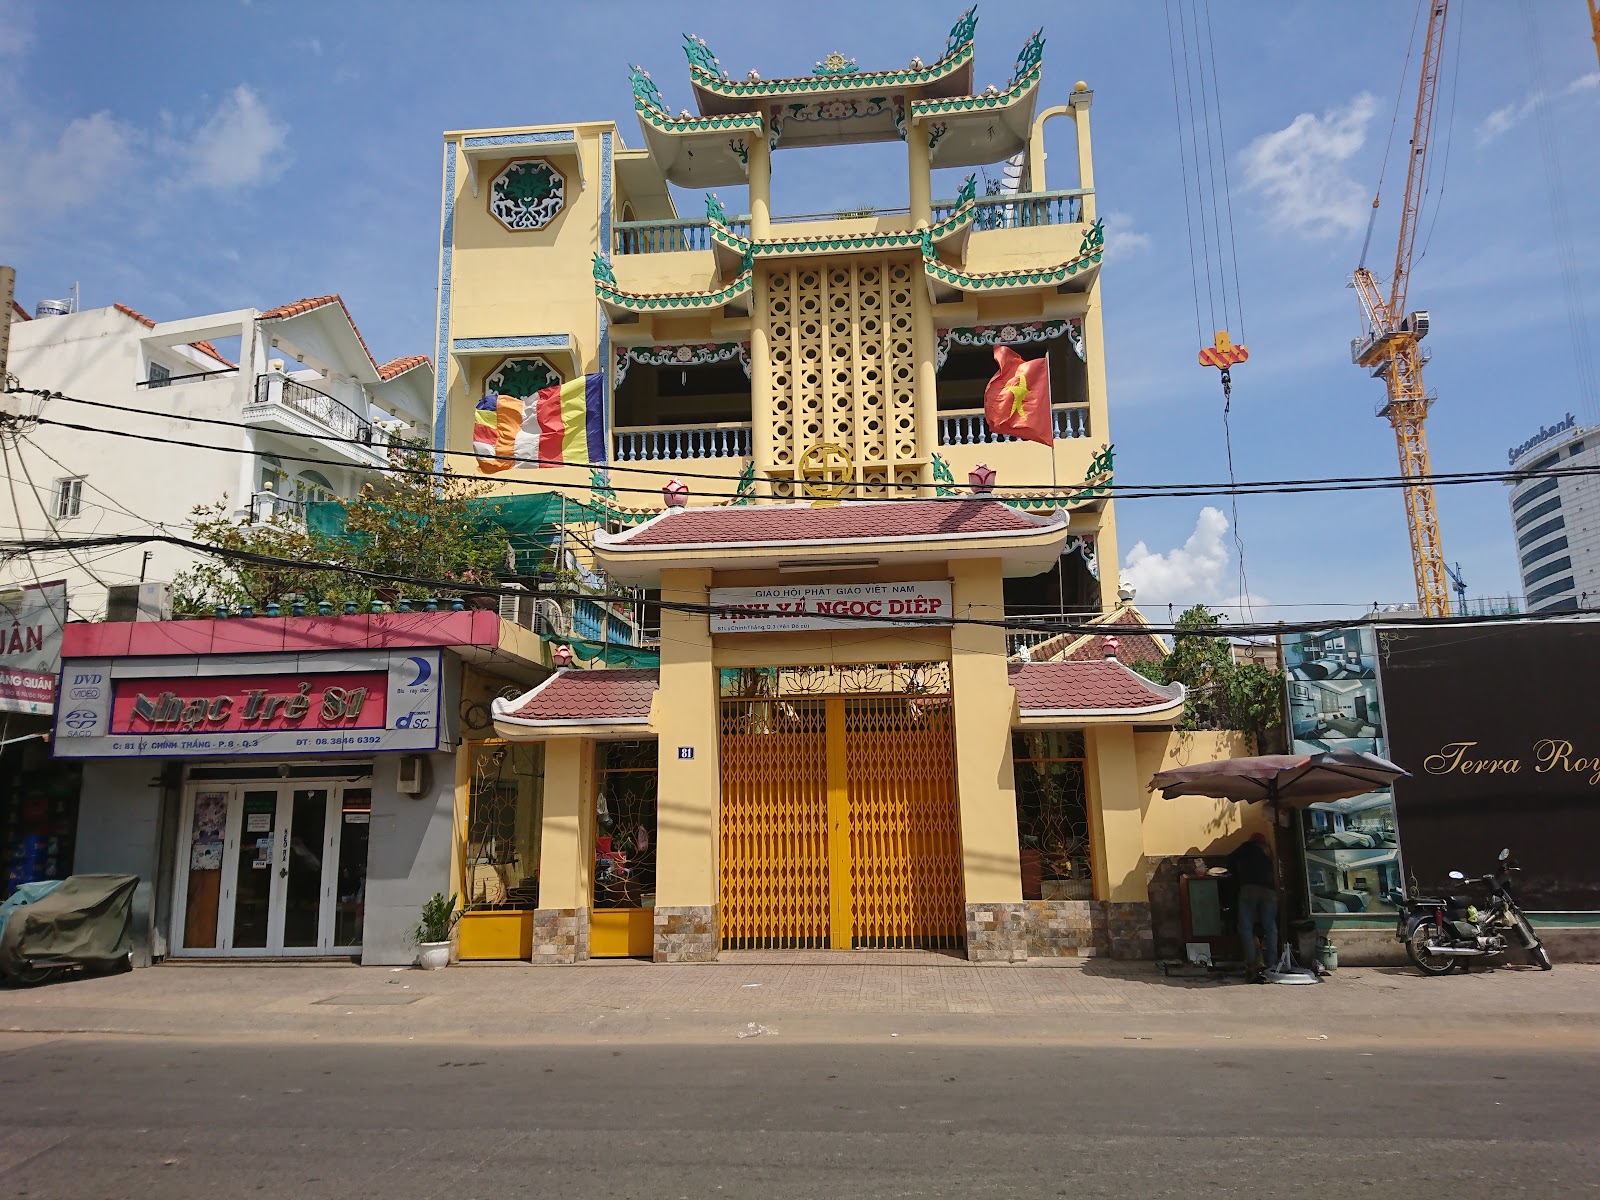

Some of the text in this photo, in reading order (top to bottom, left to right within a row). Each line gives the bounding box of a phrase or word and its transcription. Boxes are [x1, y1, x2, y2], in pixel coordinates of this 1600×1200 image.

[1508, 412, 1576, 466] Sacombank
[755, 588, 780, 598] GIÁO
[805, 586, 832, 598] PHẬT
[836, 585, 862, 595] GIÁO
[892, 585, 915, 593] NAM
[23, 676, 52, 690] QUÂN
[73, 674, 102, 685] DVD
[73, 689, 98, 698] VIDEO
[131, 691, 234, 731] Nhạc
[321, 686, 368, 721] 81
[124, 742, 135, 750] 81
[151, 740, 178, 749] CHÍNH
[242, 740, 259, 748] Q.3
[357, 736, 381, 744] 6392
[681, 748, 691, 758] 81
[1423, 741, 1522, 775] Terra
